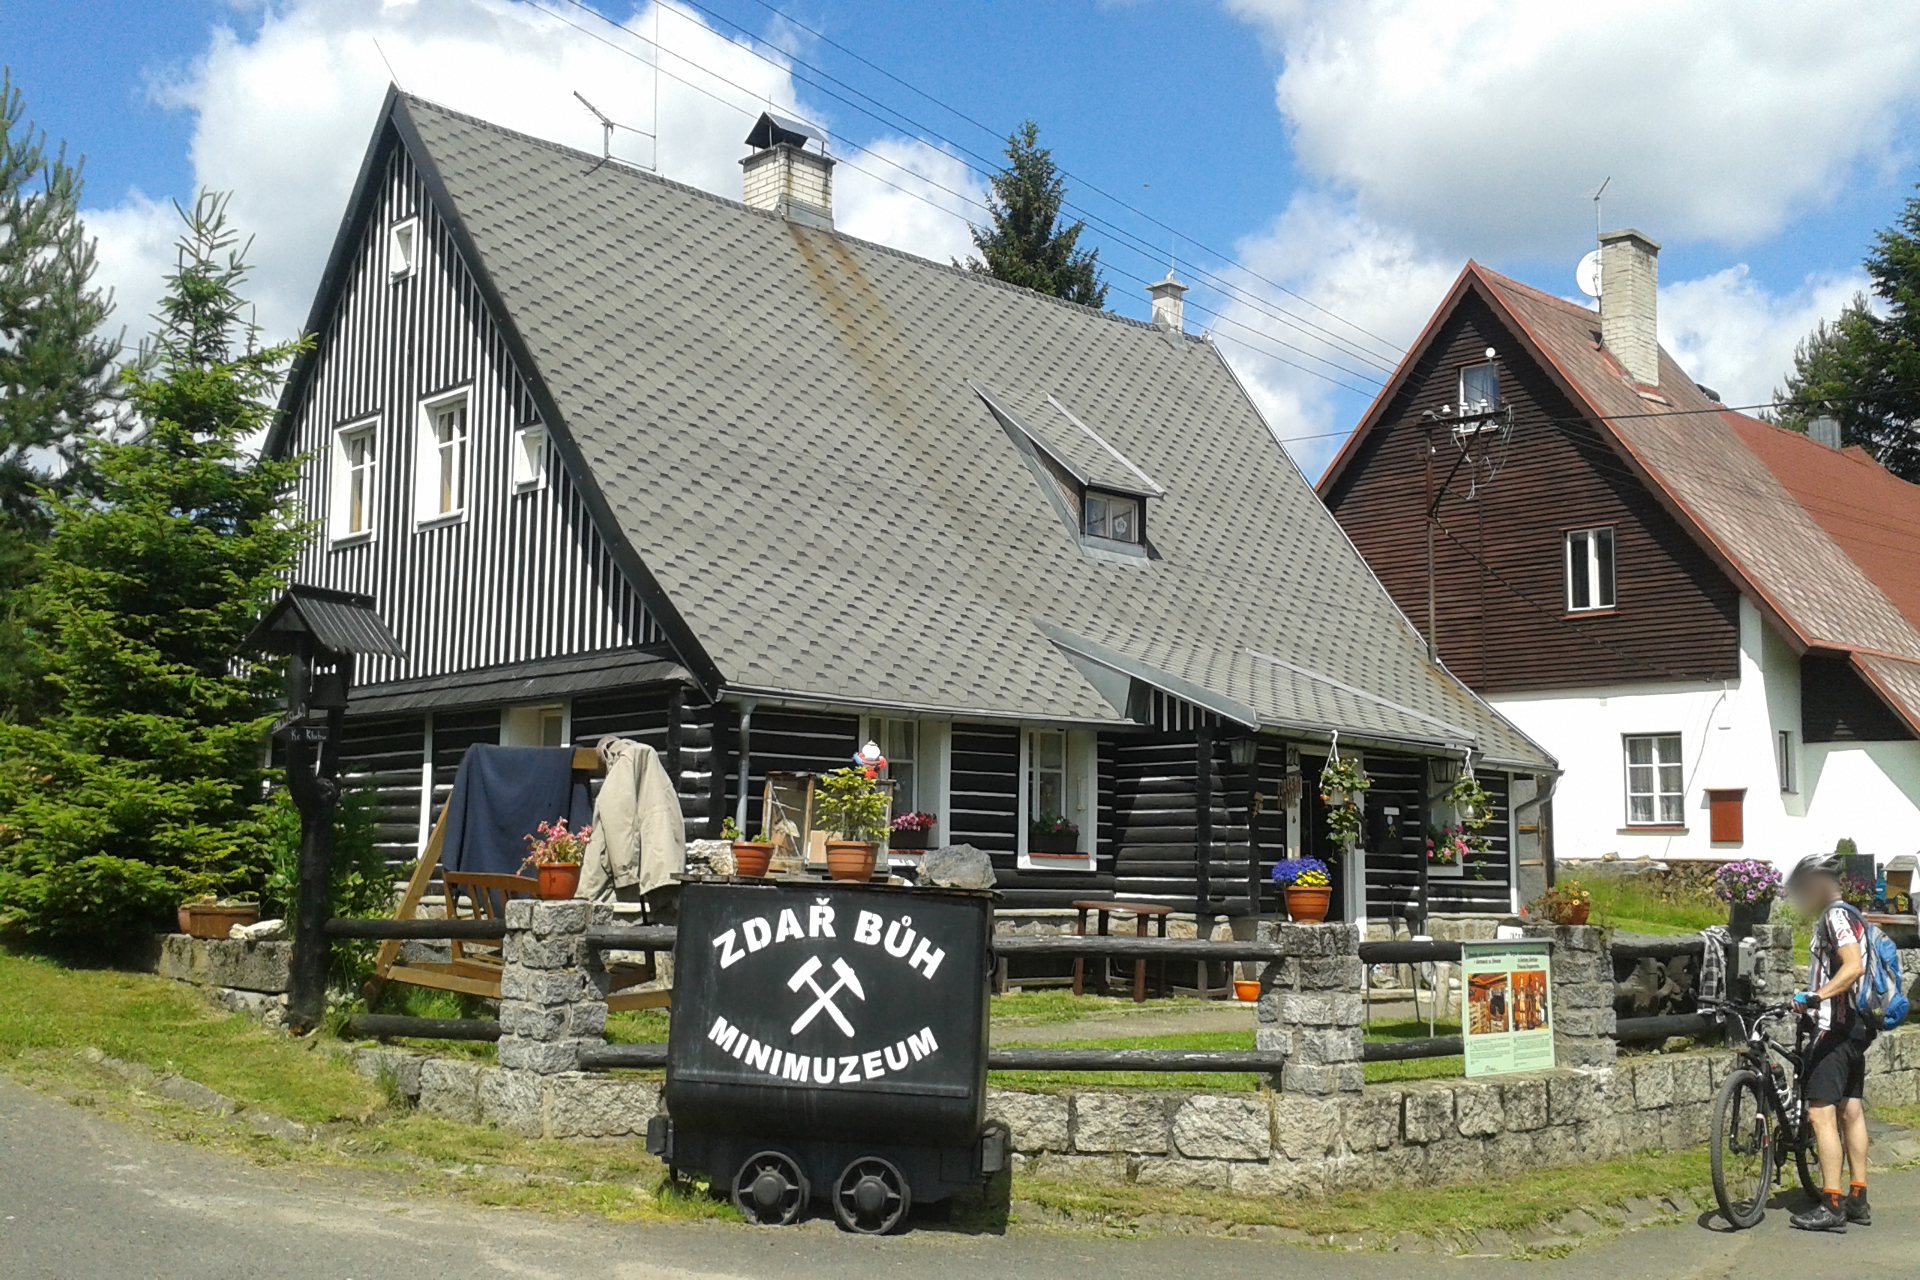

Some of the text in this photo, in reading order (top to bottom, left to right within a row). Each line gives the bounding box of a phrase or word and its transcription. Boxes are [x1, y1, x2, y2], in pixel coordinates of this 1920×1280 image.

[712, 897, 946, 980] ZDAŘ BŮH
[707, 1015, 940, 1084] MINIMUZEUM
